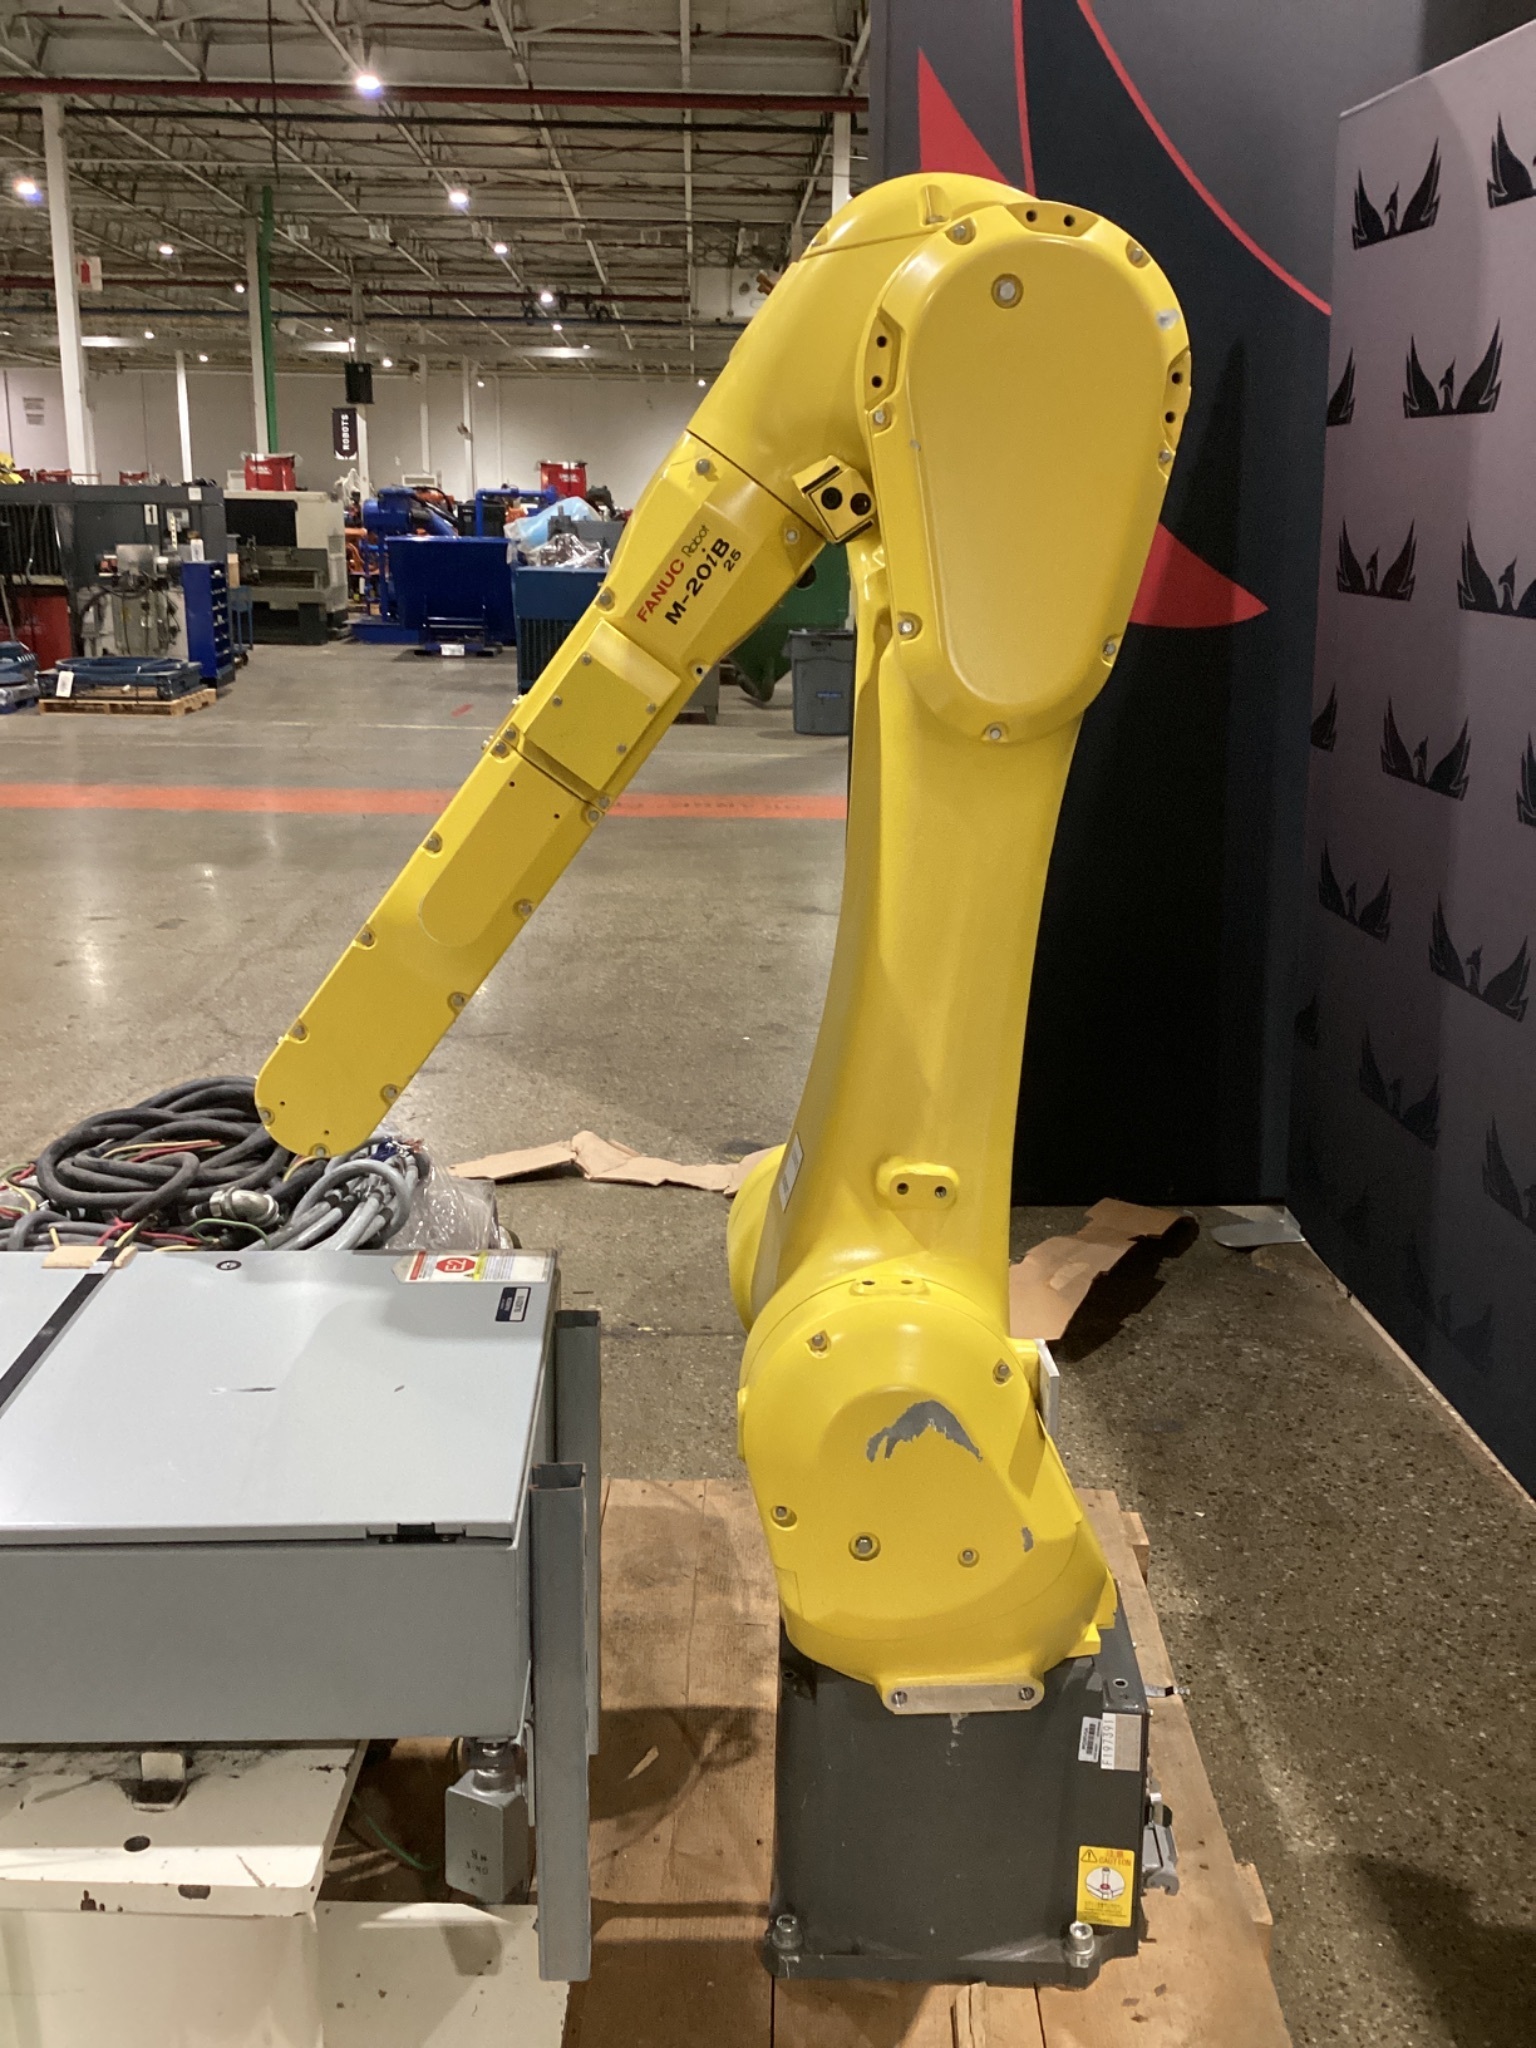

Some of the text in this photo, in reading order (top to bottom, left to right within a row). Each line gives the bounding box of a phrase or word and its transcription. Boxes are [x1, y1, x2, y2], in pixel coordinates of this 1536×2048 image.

[341, 414, 349, 450] ROBOTS
[636, 525, 709, 623] FANUC Robot
[723, 548, 742, 572] 25
[664, 538, 730, 625] M-20iB
[444, 1259, 467, 1271] E2
[1102, 1720, 1114, 1766] F197391
